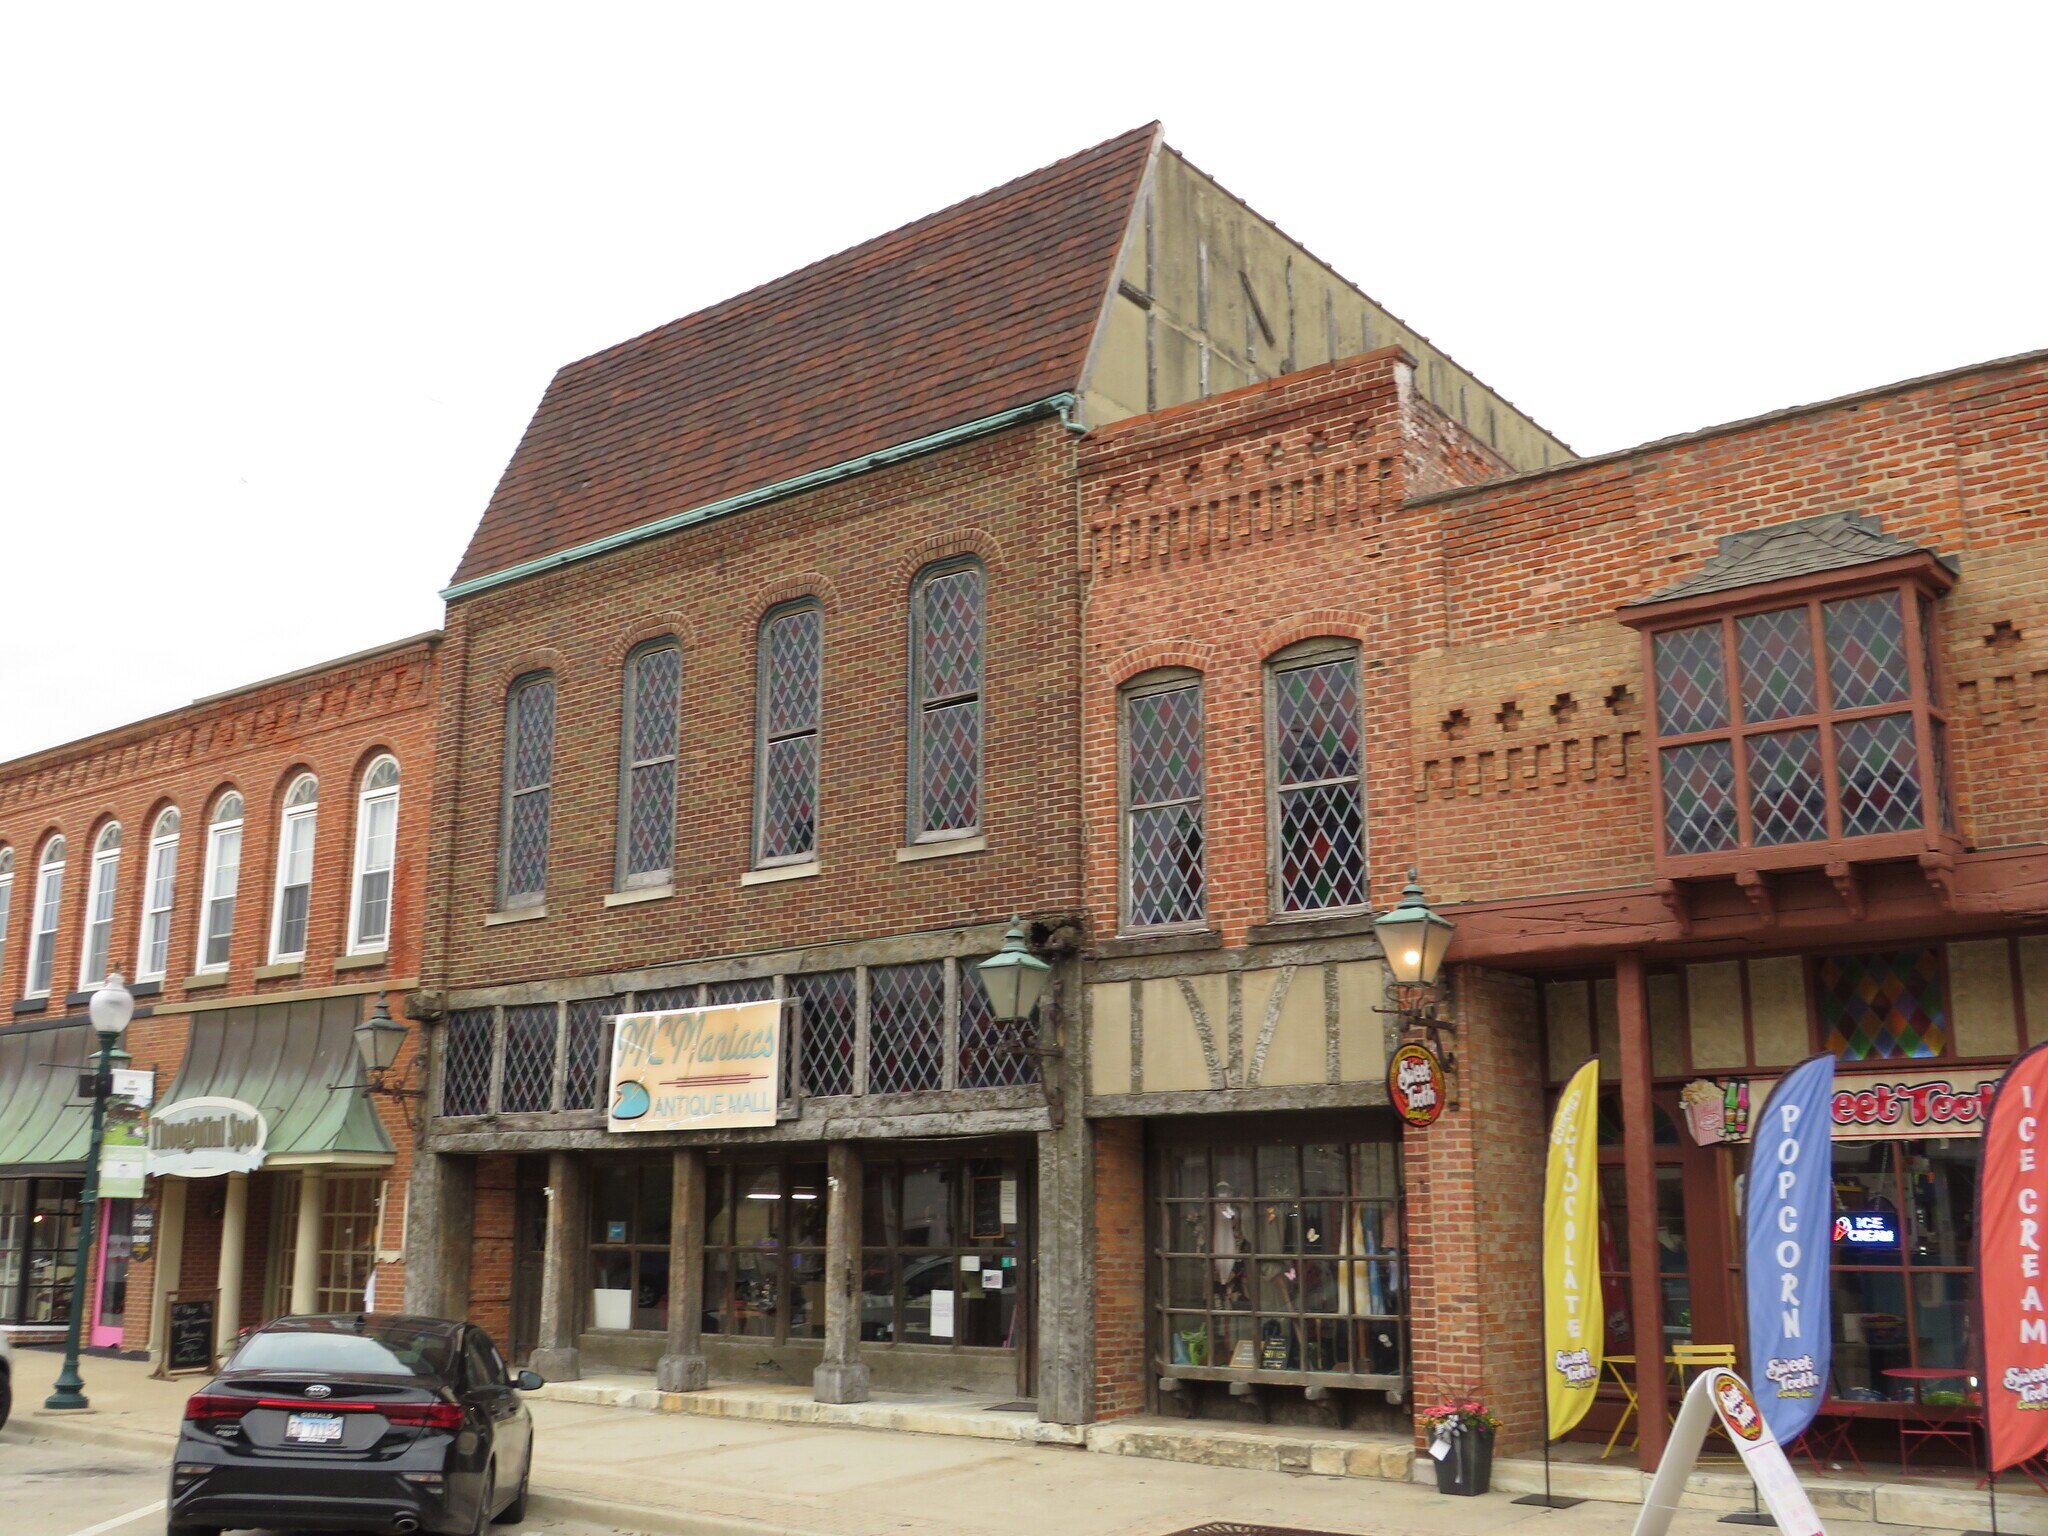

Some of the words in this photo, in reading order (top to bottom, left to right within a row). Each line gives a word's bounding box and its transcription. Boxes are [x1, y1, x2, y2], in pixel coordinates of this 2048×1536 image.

[1397, 1059, 1432, 1091] Sweet
[653, 1094, 725, 1117] ANTIQUE
[728, 1091, 770, 1114] MALL
[1405, 1083, 1437, 1109] Tooth
[1832, 1084, 1902, 1125] eet
[1896, 1080, 1998, 1125] Toot
[2018, 1085, 2038, 1173] ICE
[1775, 1104, 1801, 1339] POPCORN
[1855, 1216, 1885, 1229] ICE
[2017, 1187, 2048, 1345] CREAM
[1555, 1348, 1589, 1371] Sweet
[1765, 1354, 1814, 1381] Sweet
[1779, 1371, 1820, 1390] Tooth
